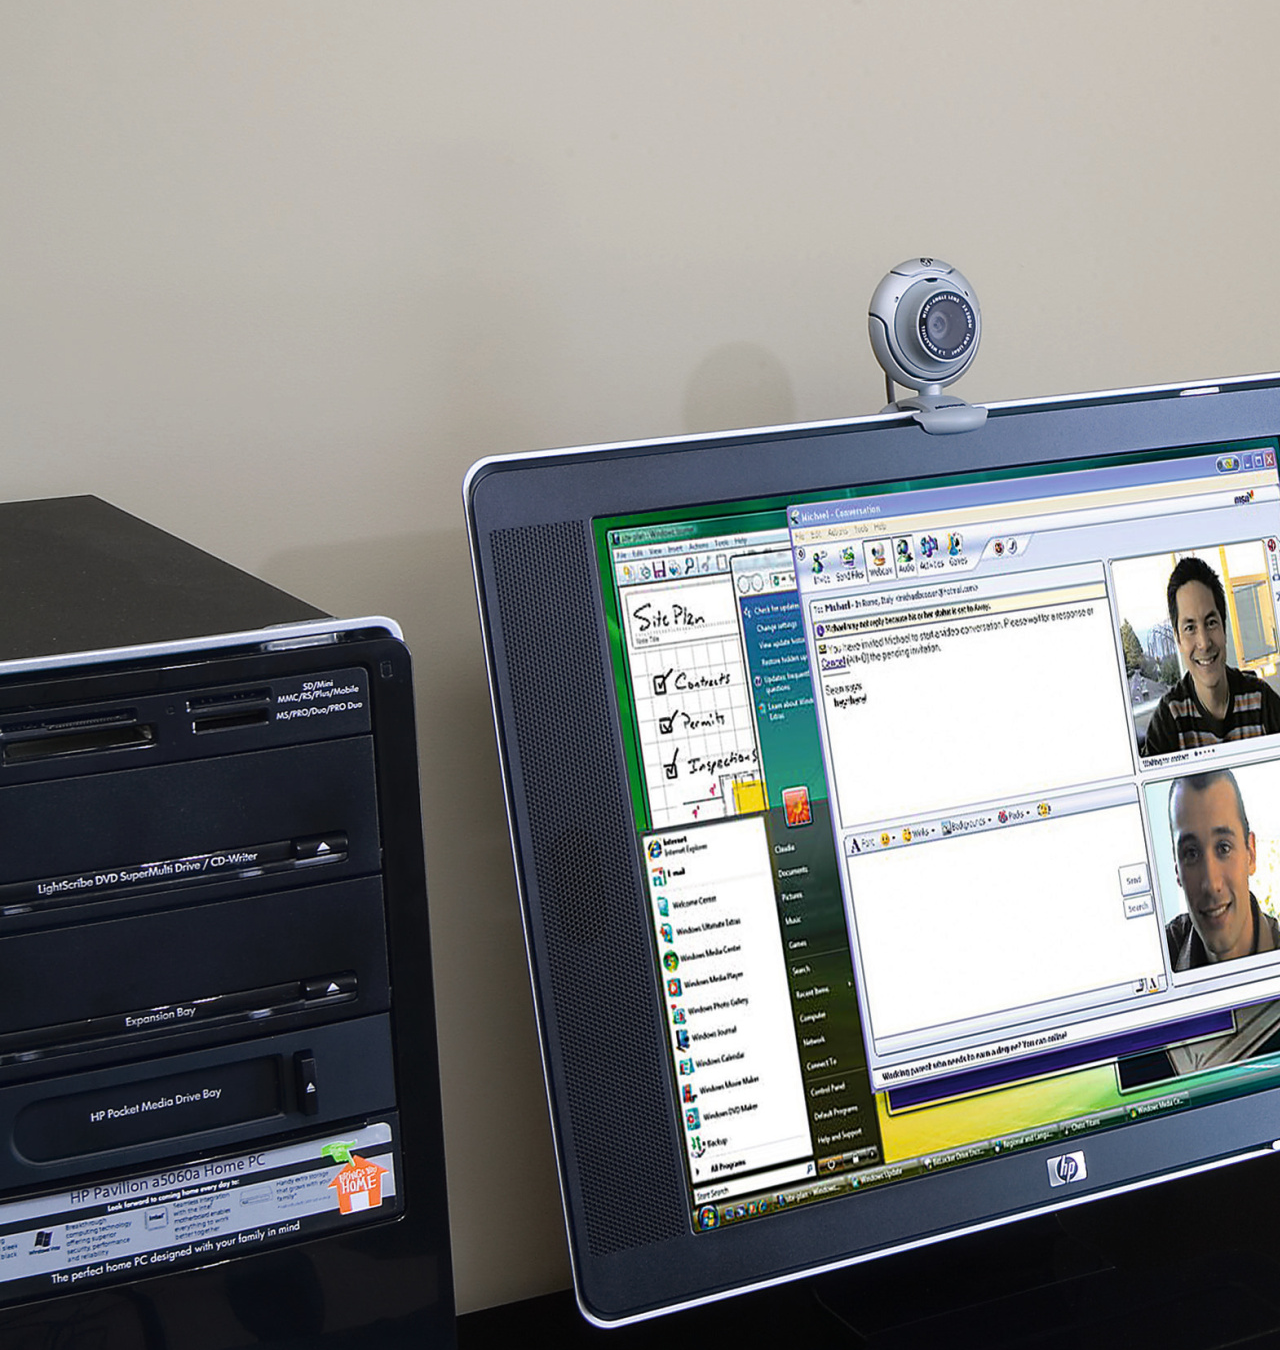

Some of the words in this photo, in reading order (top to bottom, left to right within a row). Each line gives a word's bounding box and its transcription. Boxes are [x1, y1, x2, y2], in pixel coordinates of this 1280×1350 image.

[347, 701, 363, 710] Duo
[37, 878, 93, 896] LightScribe
[95, 872, 119, 887] DVD
[120, 863, 173, 883] SuperMulti
[175, 861, 201, 874] Drive
[210, 852, 258, 867] CD-Writer
[125, 1010, 175, 1027] Expansion
[176, 1007, 196, 1018] Bay
[90, 1111, 106, 1123] HP
[107, 1104, 140, 1119] Pocket
[141, 1098, 174, 1112] Media
[175, 1093, 201, 1106] Drive
[202, 1089, 222, 1099] Bay
[70, 1189, 90, 1205] HP
[94, 1179, 148, 1200] Pavilion
[152, 1168, 200, 1189] a5060a
[204, 1160, 245, 1178] Home
[248, 1152, 266, 1168] PC
[340, 1173, 377, 1194] HOME
[51, 1273, 69, 1284] The
[71, 1265, 104, 1283] perfect
[106, 1261, 131, 1273] home
[134, 1255, 148, 1267] PC
[150, 1246, 191, 1262] designed
[194, 1240, 213, 1253] with
[216, 1237, 236, 1251] your
[238, 1231, 265, 1244] family
[267, 1226, 277, 1236] in
[279, 1221, 300, 1234] mind
